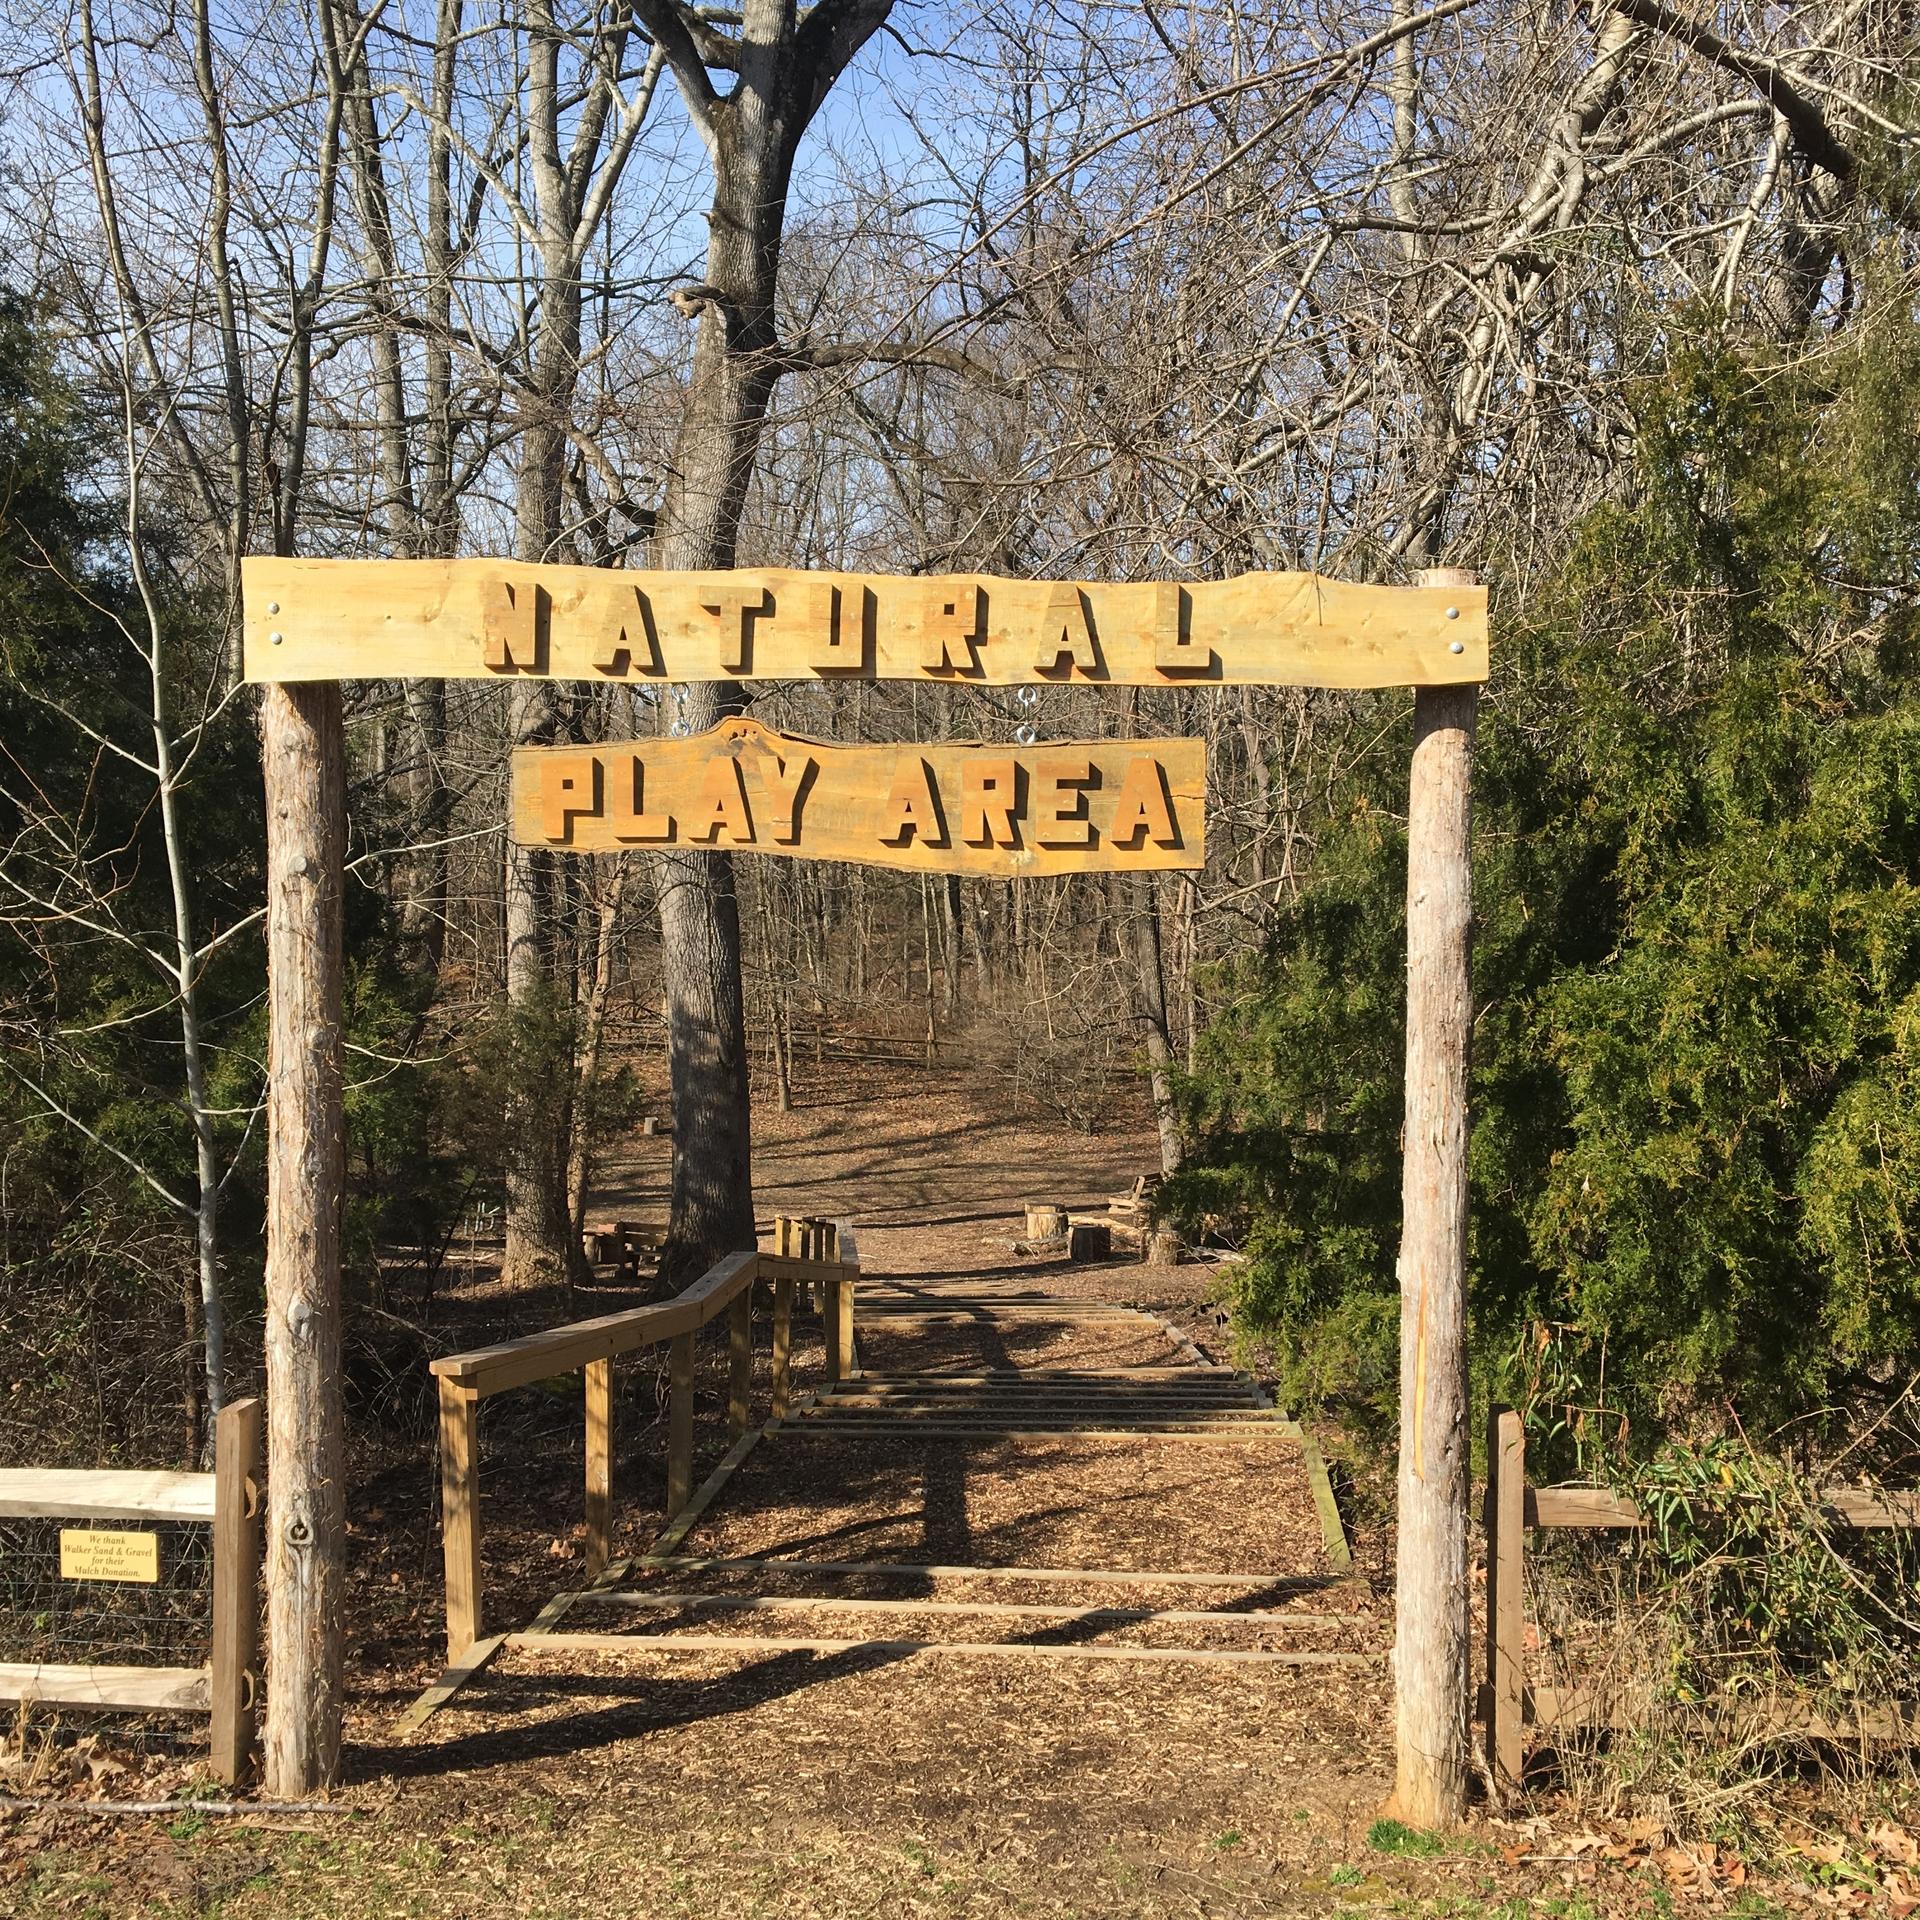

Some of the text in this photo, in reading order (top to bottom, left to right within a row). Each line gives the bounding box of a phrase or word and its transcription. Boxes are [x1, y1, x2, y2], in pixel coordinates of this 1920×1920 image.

[484, 582, 1222, 681] NATURAL
[540, 755, 1184, 850] PLAY AREA
[89, 1535, 126, 1545] We thank
[64, 1544, 153, 1557] Walker Sand & Gravel
[91, 1556, 125, 1566] for their
[74, 1566, 141, 1577] Mulch Donation.
